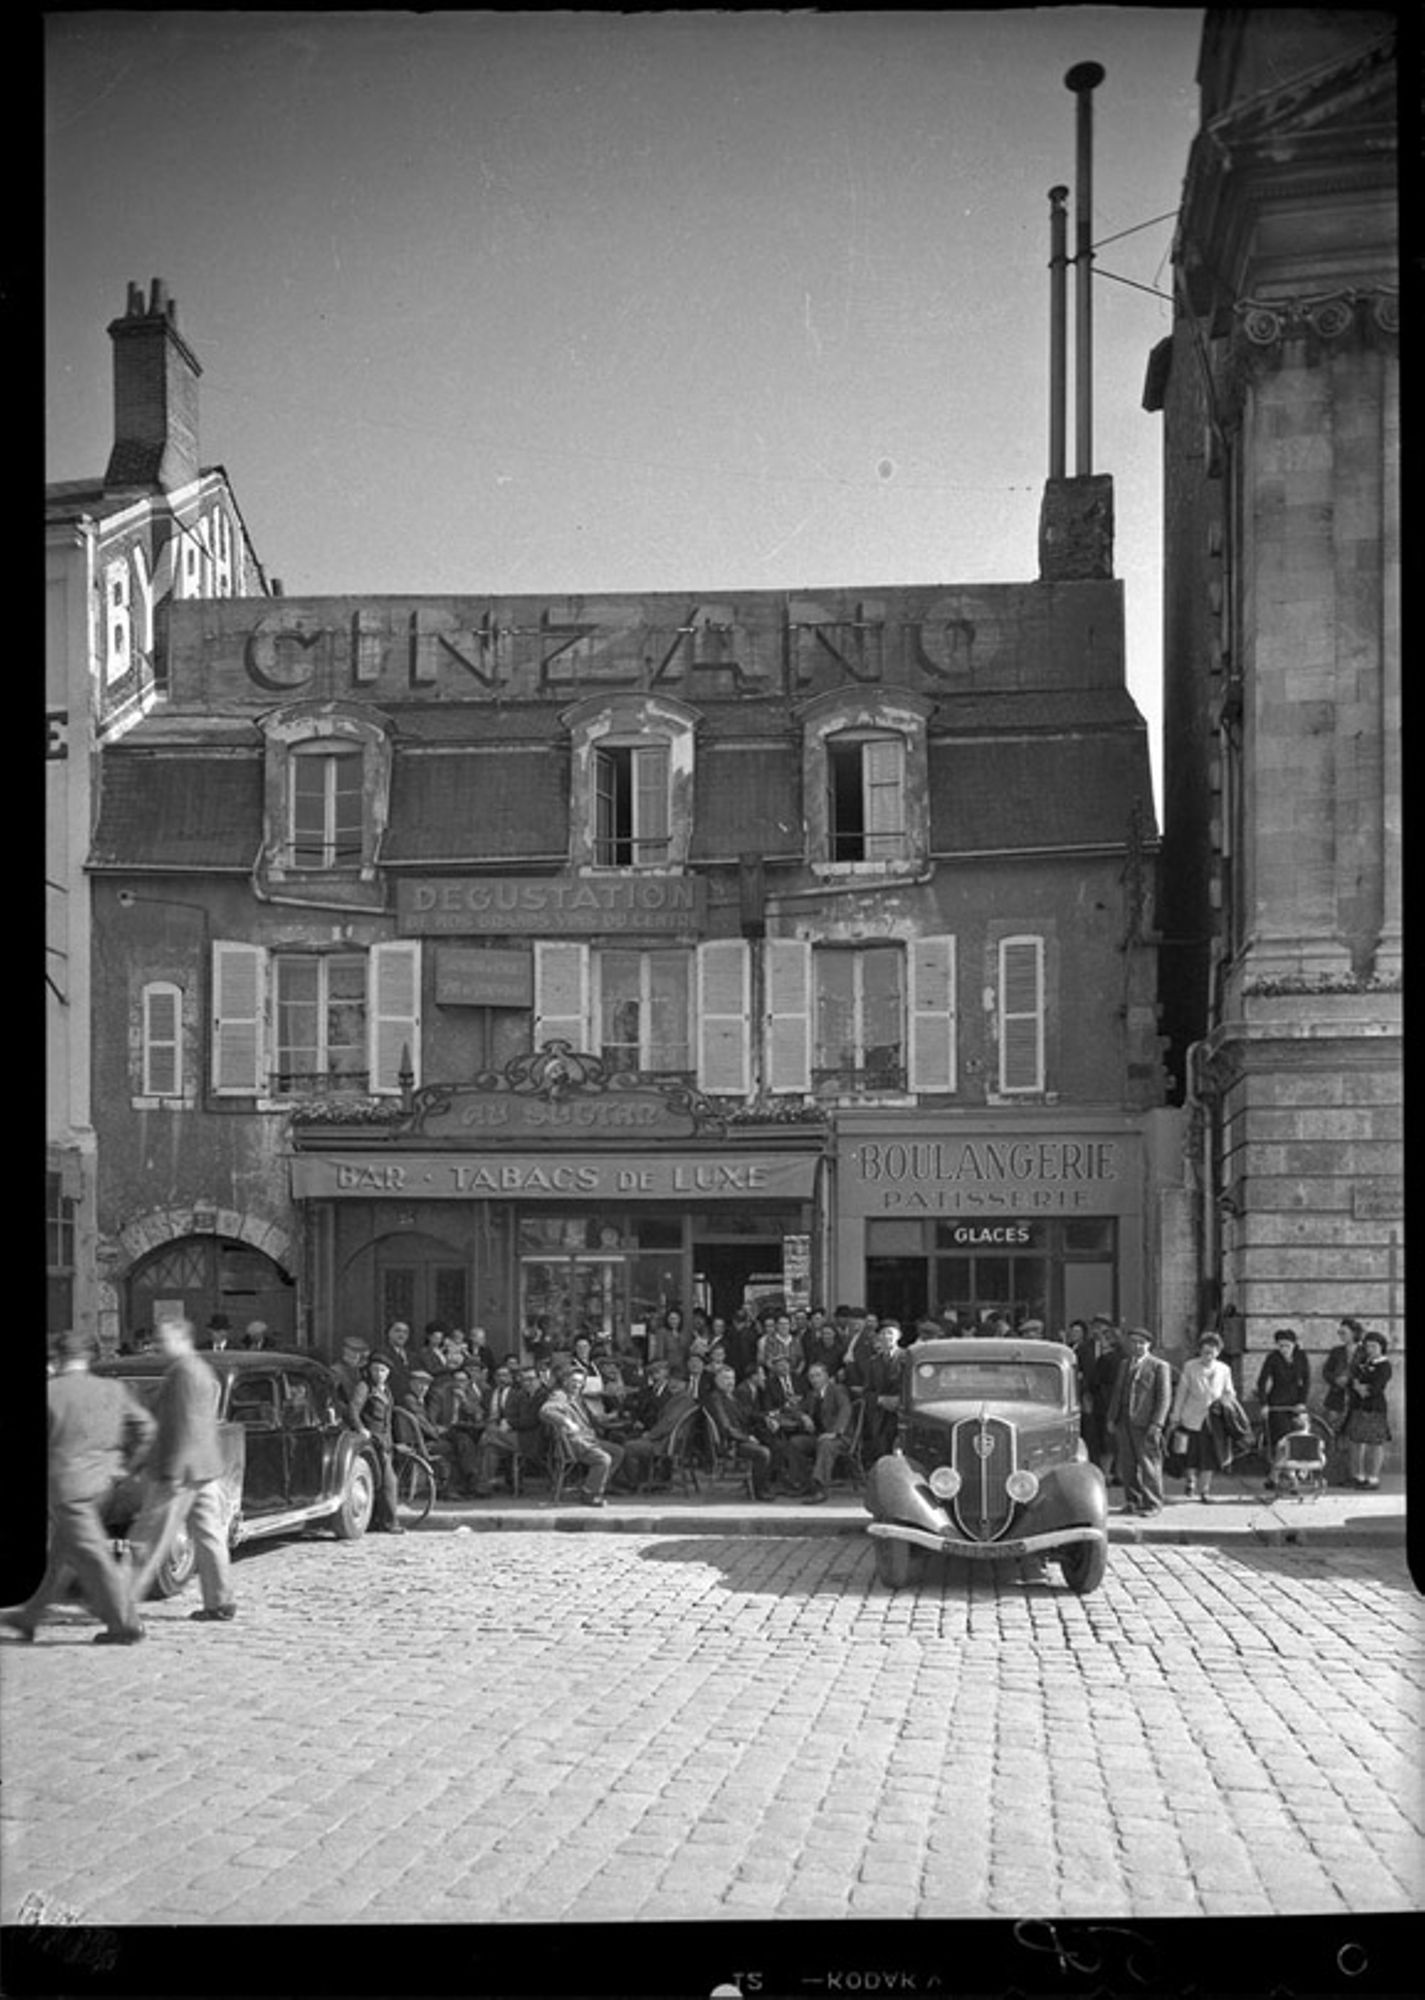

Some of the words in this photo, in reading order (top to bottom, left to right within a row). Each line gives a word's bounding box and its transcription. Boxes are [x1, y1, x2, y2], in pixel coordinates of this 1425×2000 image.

[243, 595, 1001, 689] CINZANO
[414, 883, 695, 911] DEGUSTATION
[860, 1143, 1116, 1181] BOULANGERIE
[337, 1166, 407, 1190] BAR
[450, 1166, 599, 1192] TABACS
[618, 1170, 655, 1191] DE
[671, 1166, 769, 1191] LUXE
[883, 1190, 1089, 1209] PATISSERIE
[954, 1227, 1030, 1243] GLACES
